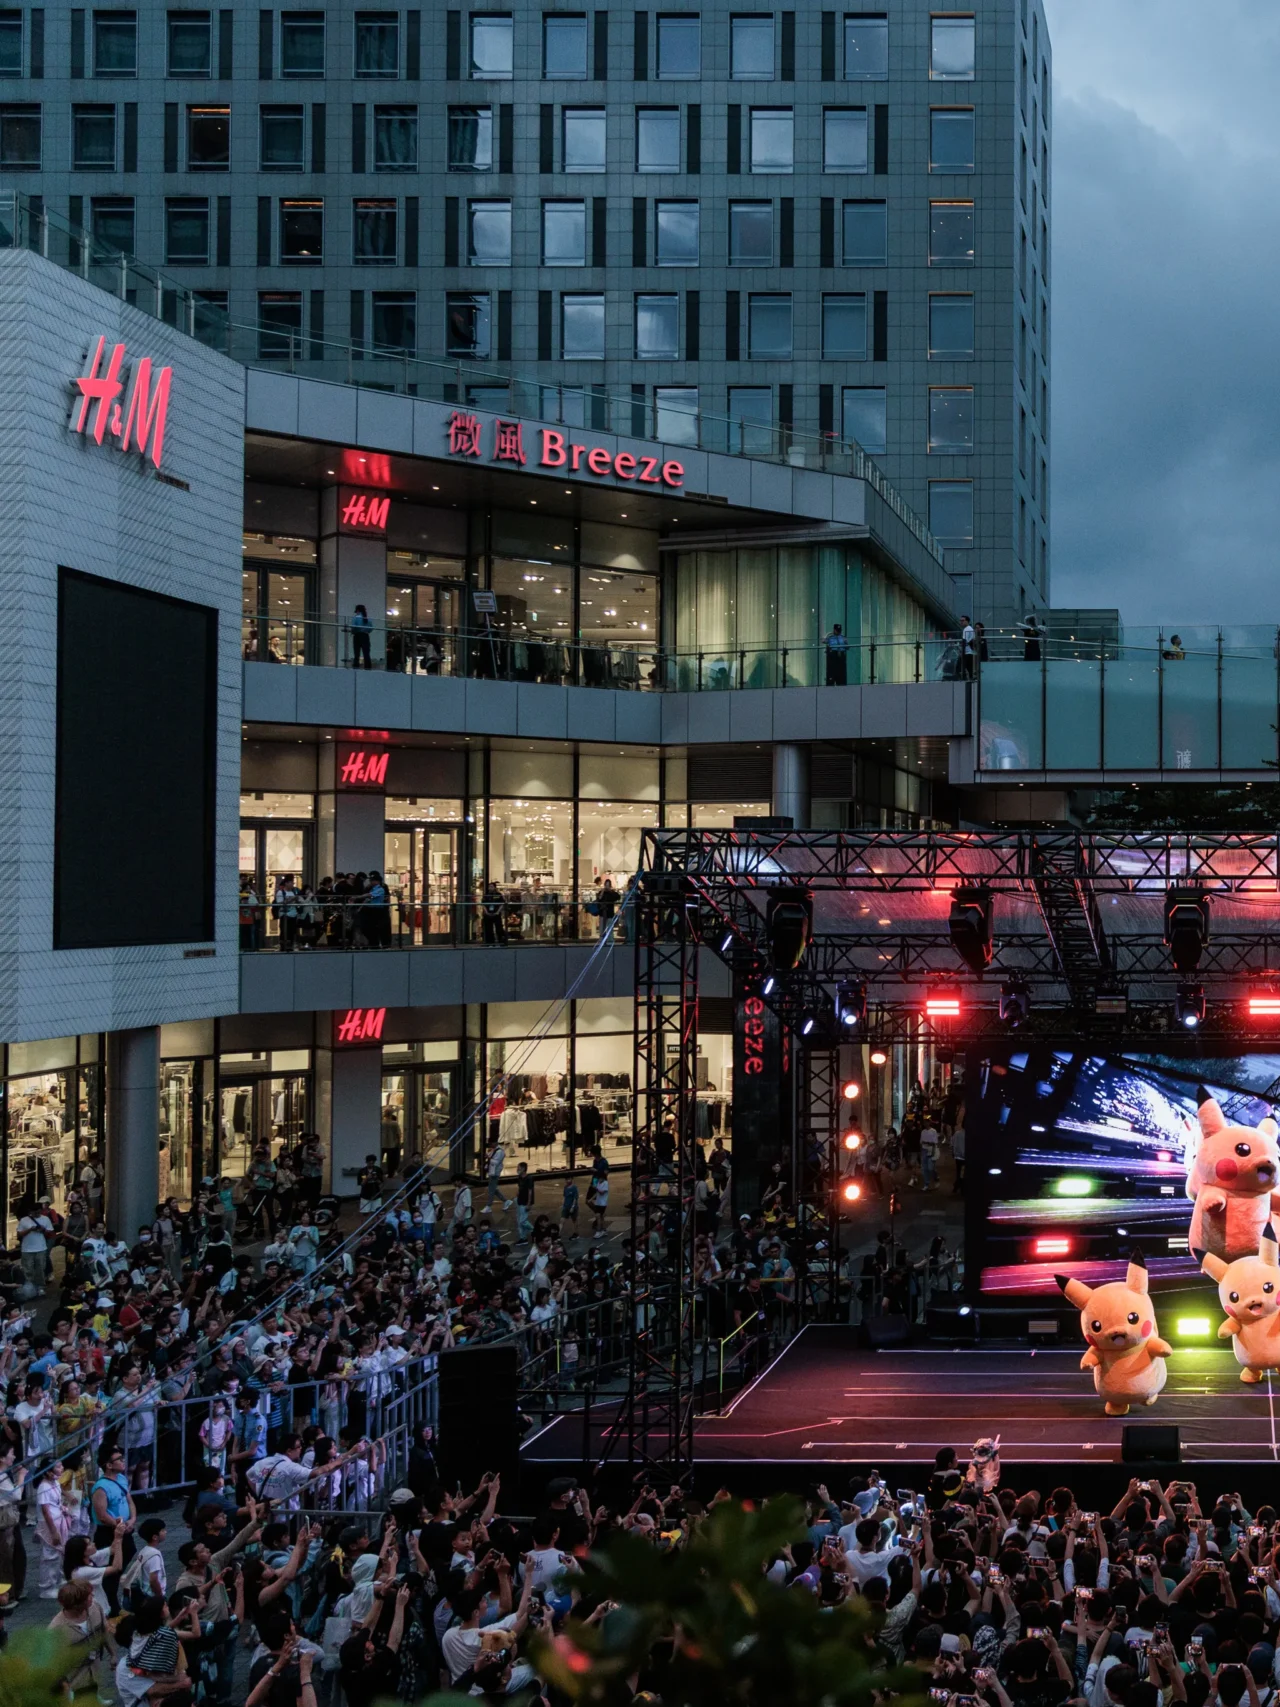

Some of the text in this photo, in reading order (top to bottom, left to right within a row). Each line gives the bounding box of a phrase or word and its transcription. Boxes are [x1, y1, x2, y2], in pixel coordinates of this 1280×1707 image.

[76, 334, 173, 469] H&M
[447, 411, 685, 487] 微風 Breeze
[342, 494, 391, 529] H&M
[341, 752, 390, 784] H&M
[338, 1008, 386, 1041] H&M
